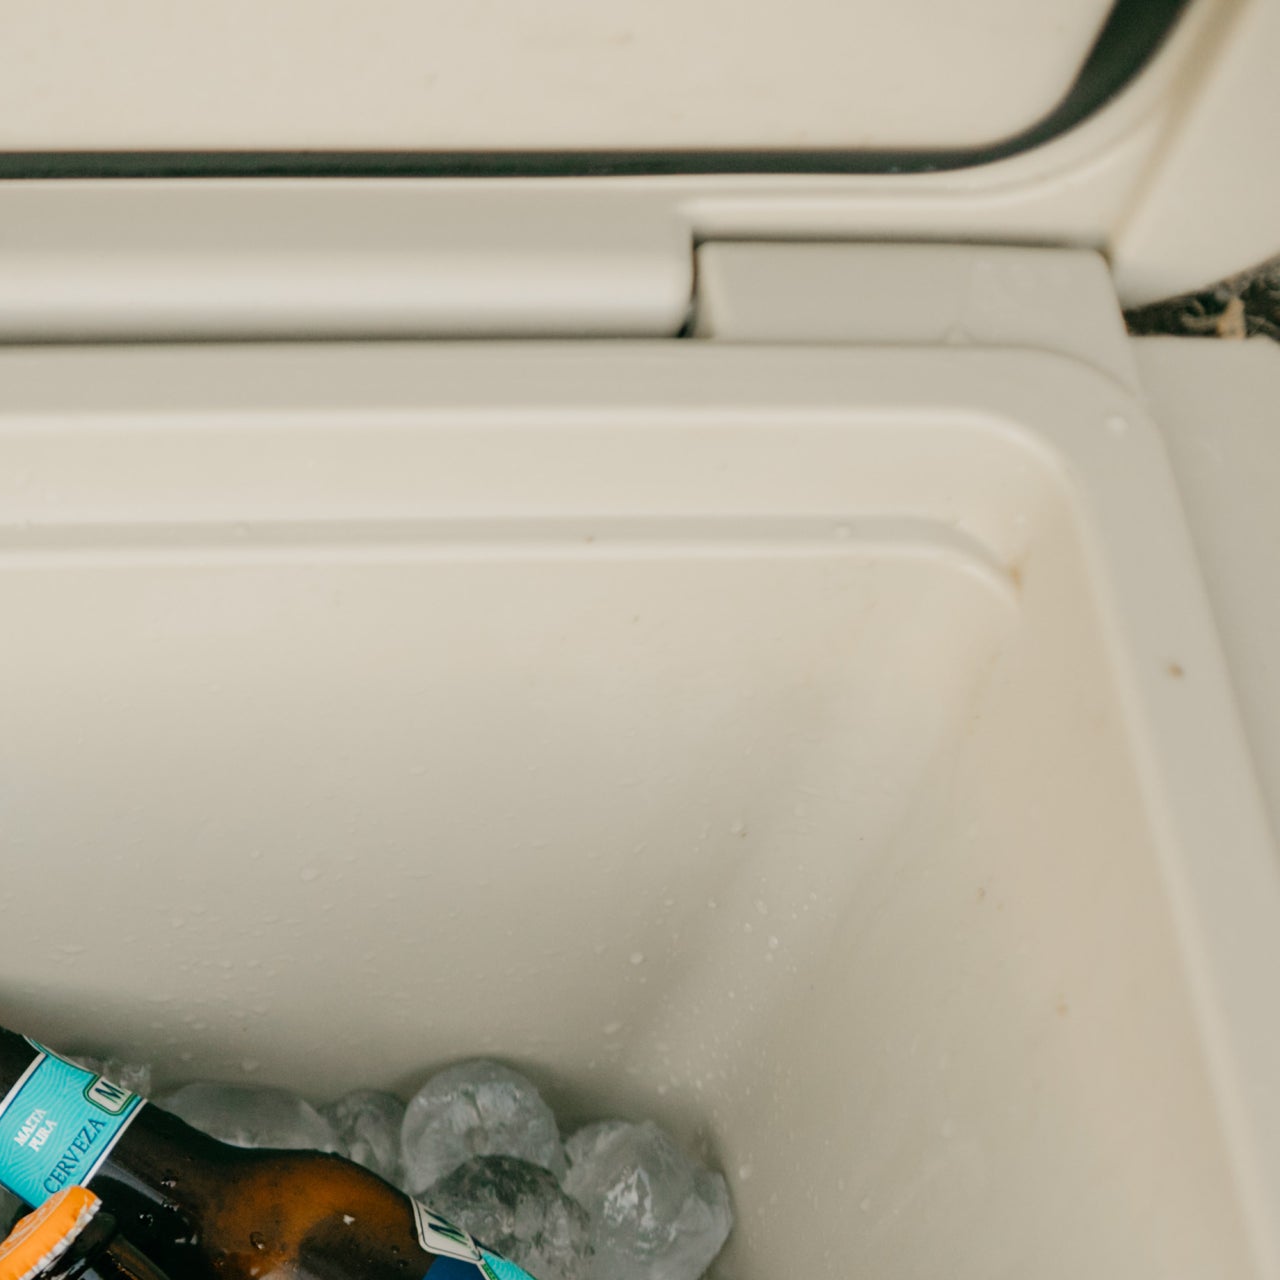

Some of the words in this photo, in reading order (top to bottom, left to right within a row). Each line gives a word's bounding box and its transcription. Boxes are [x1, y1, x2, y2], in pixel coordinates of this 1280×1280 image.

[14, 1108, 47, 1147] MALTA
[28, 1119, 58, 1152] PURA
[43, 1118, 106, 1195] CERVEZA
